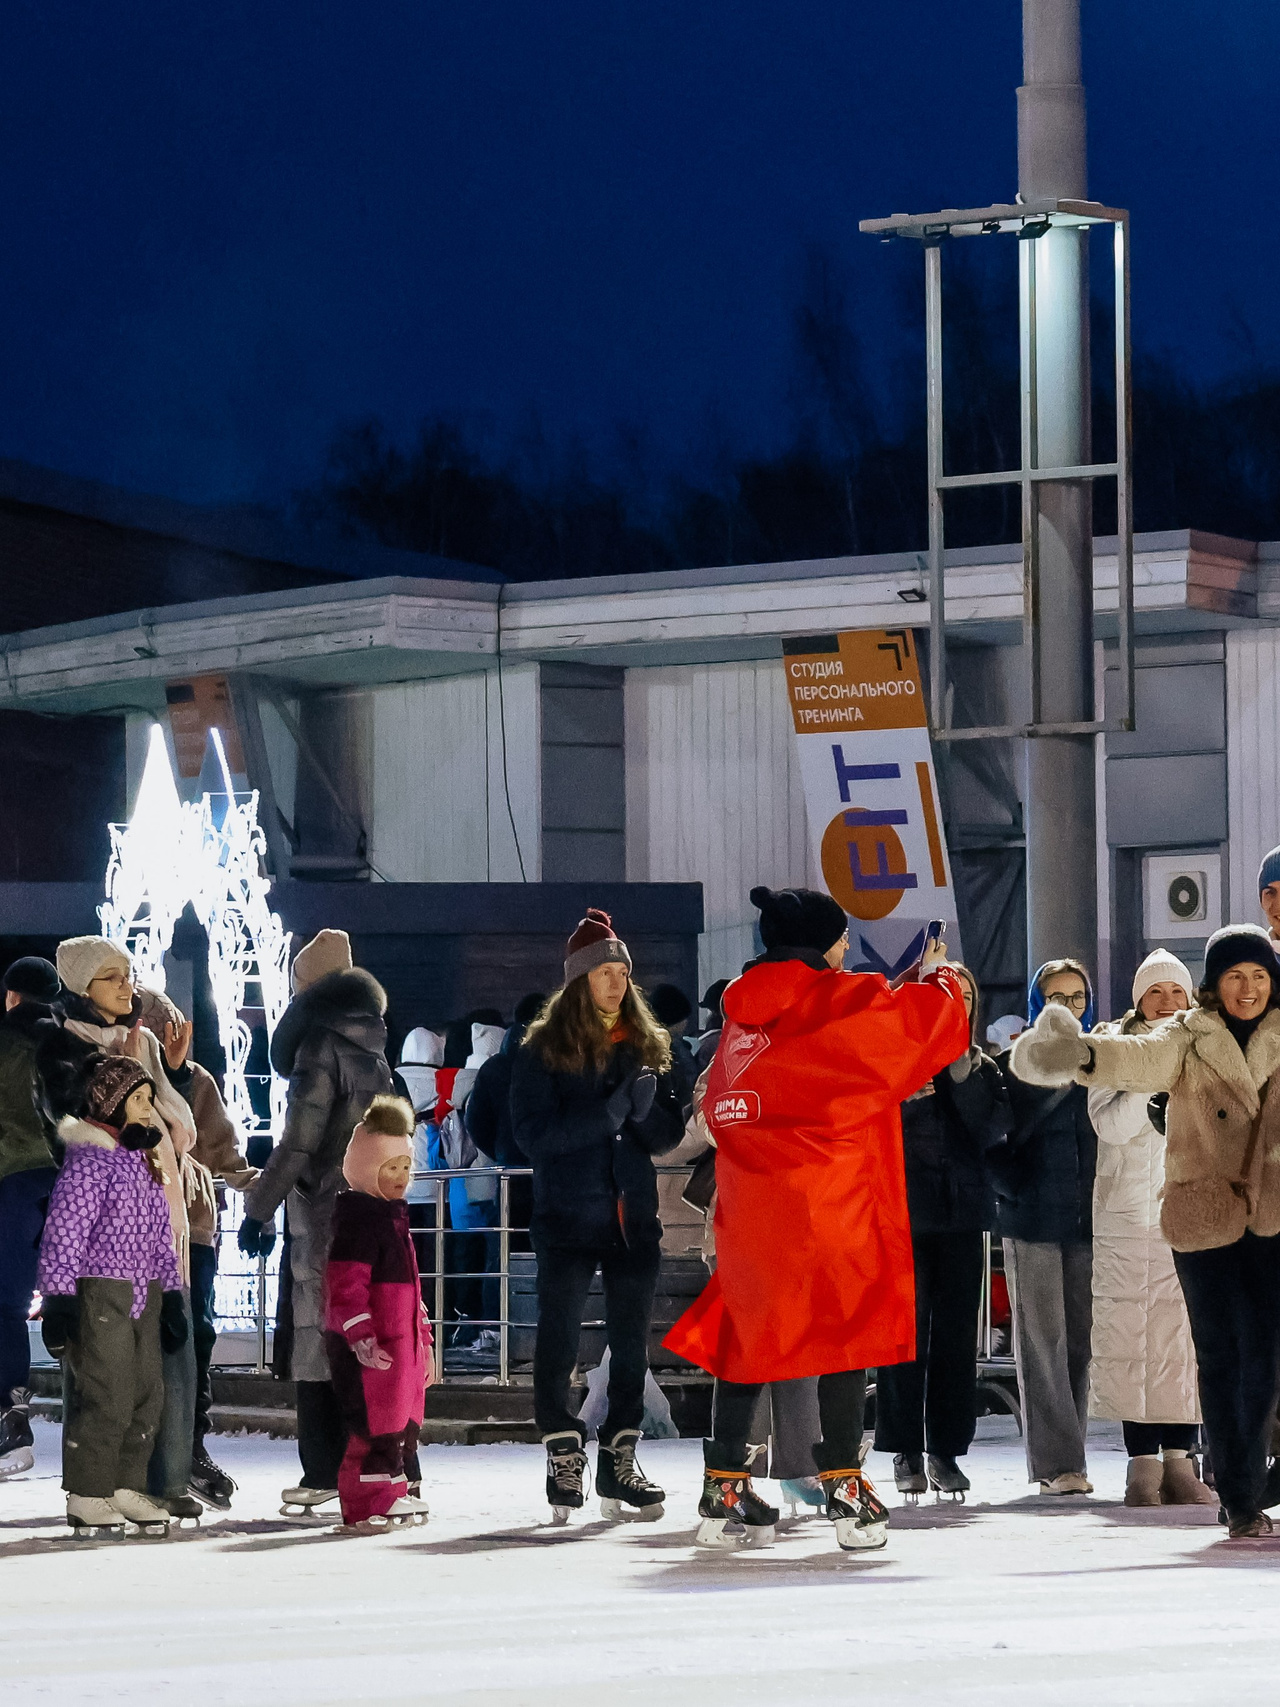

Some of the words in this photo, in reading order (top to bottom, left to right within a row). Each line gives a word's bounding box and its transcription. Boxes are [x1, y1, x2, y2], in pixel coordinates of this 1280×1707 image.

[790, 661, 844, 679] СТУДИЯ
[794, 679, 916, 702] ПЕРСОНАЛЬНОГО
[798, 706, 864, 725] ТРЕНИНГА
